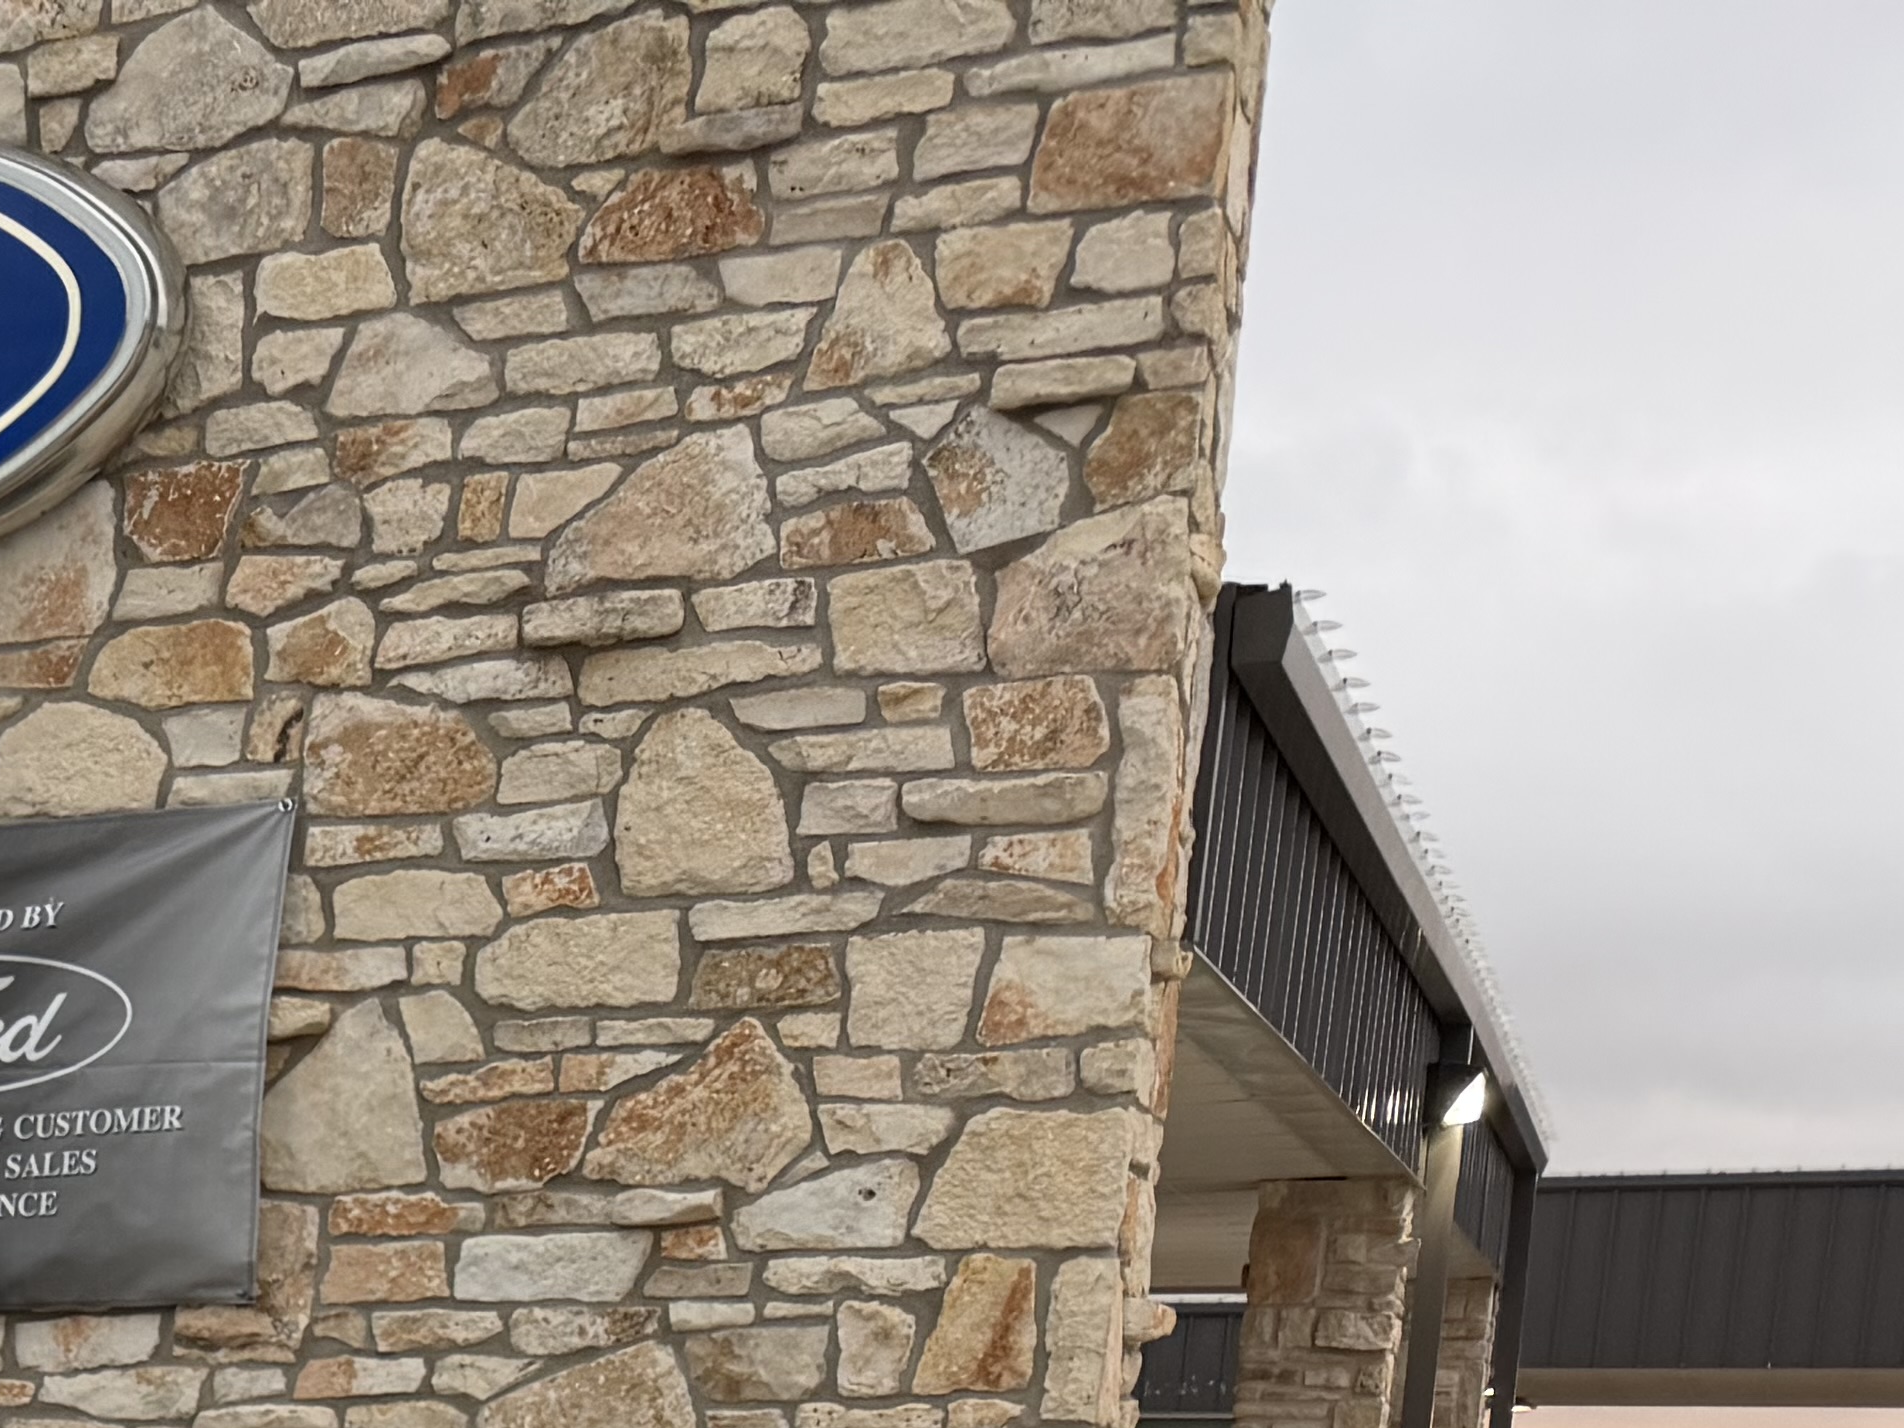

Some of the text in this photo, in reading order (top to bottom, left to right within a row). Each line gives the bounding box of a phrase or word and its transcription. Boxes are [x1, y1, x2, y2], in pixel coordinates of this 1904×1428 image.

[20, 901, 64, 930] BY
[13, 1104, 185, 1141] CUSTOMER
[4, 1149, 98, 1179] SALES
